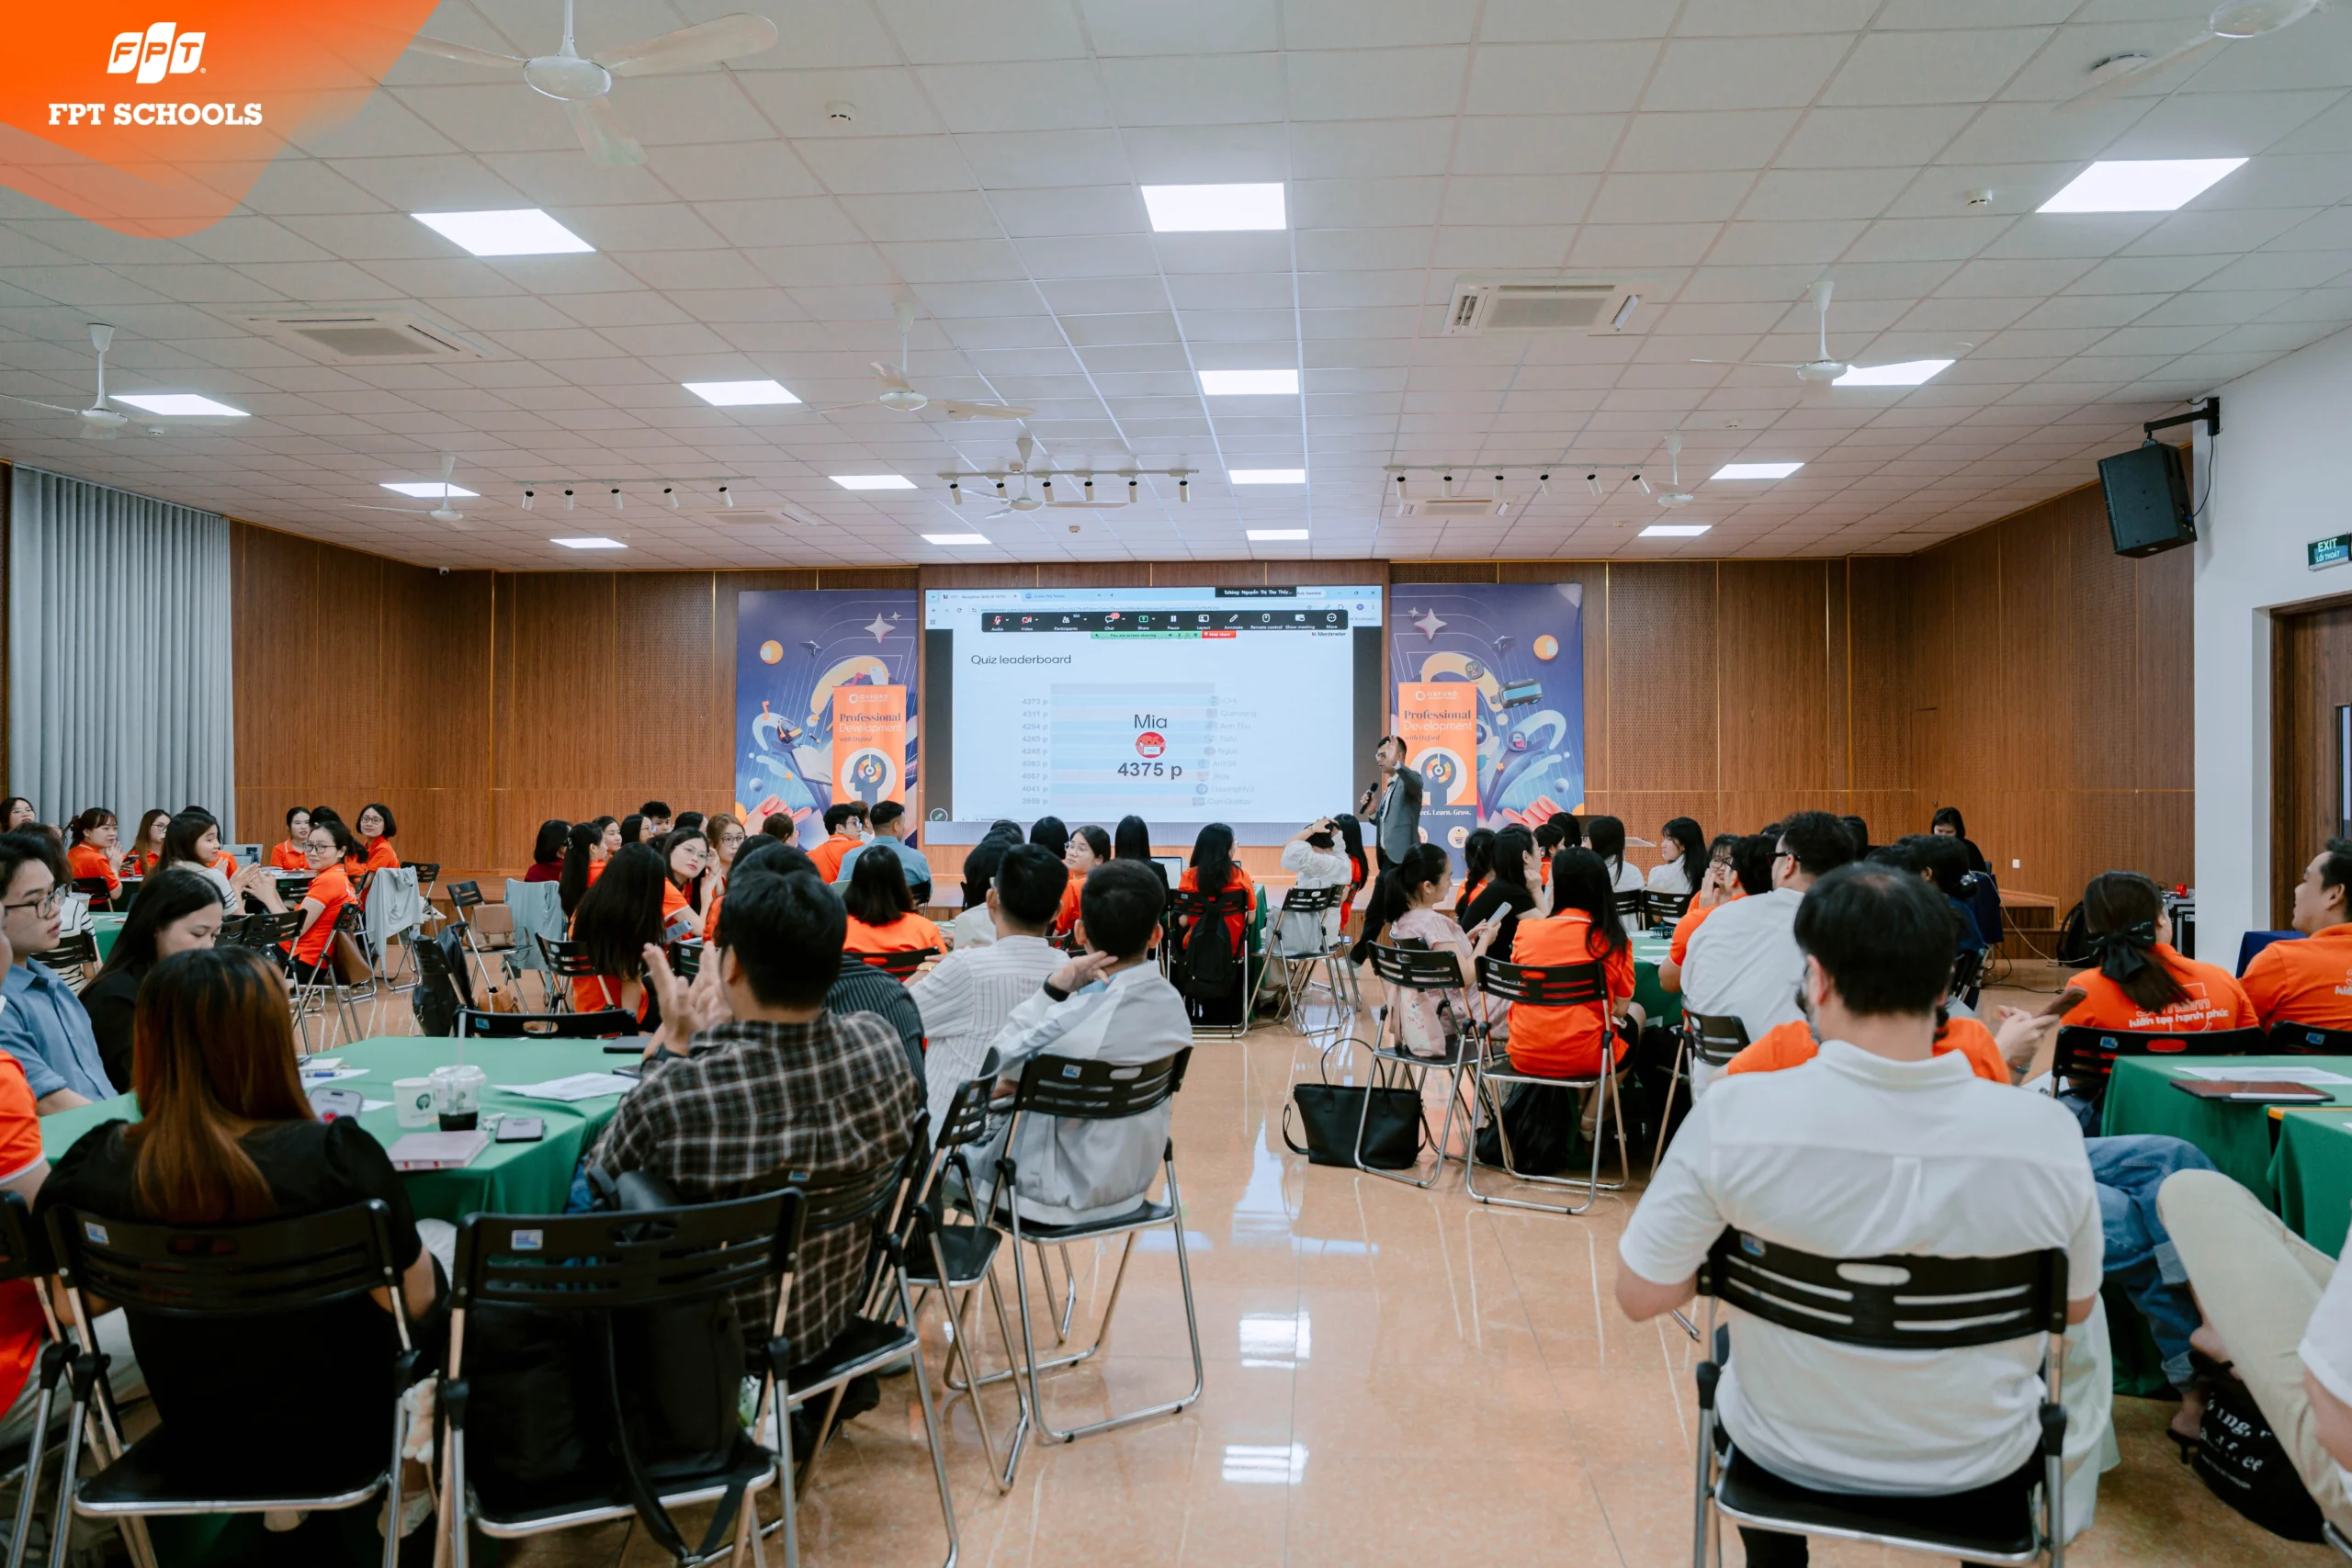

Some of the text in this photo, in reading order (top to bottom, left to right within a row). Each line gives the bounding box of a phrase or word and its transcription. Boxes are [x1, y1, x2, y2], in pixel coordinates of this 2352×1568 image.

[2318, 538, 2337, 552] EXIT
[971, 655, 1071, 665] Quiz leaderboard
[840, 713, 901, 722] Professional
[1404, 709, 1471, 719] Professional
[1134, 714, 1168, 728] Mia
[1403, 720, 1472, 732] Development
[840, 723, 901, 733] Development
[1117, 762, 1182, 780] 4375 p
